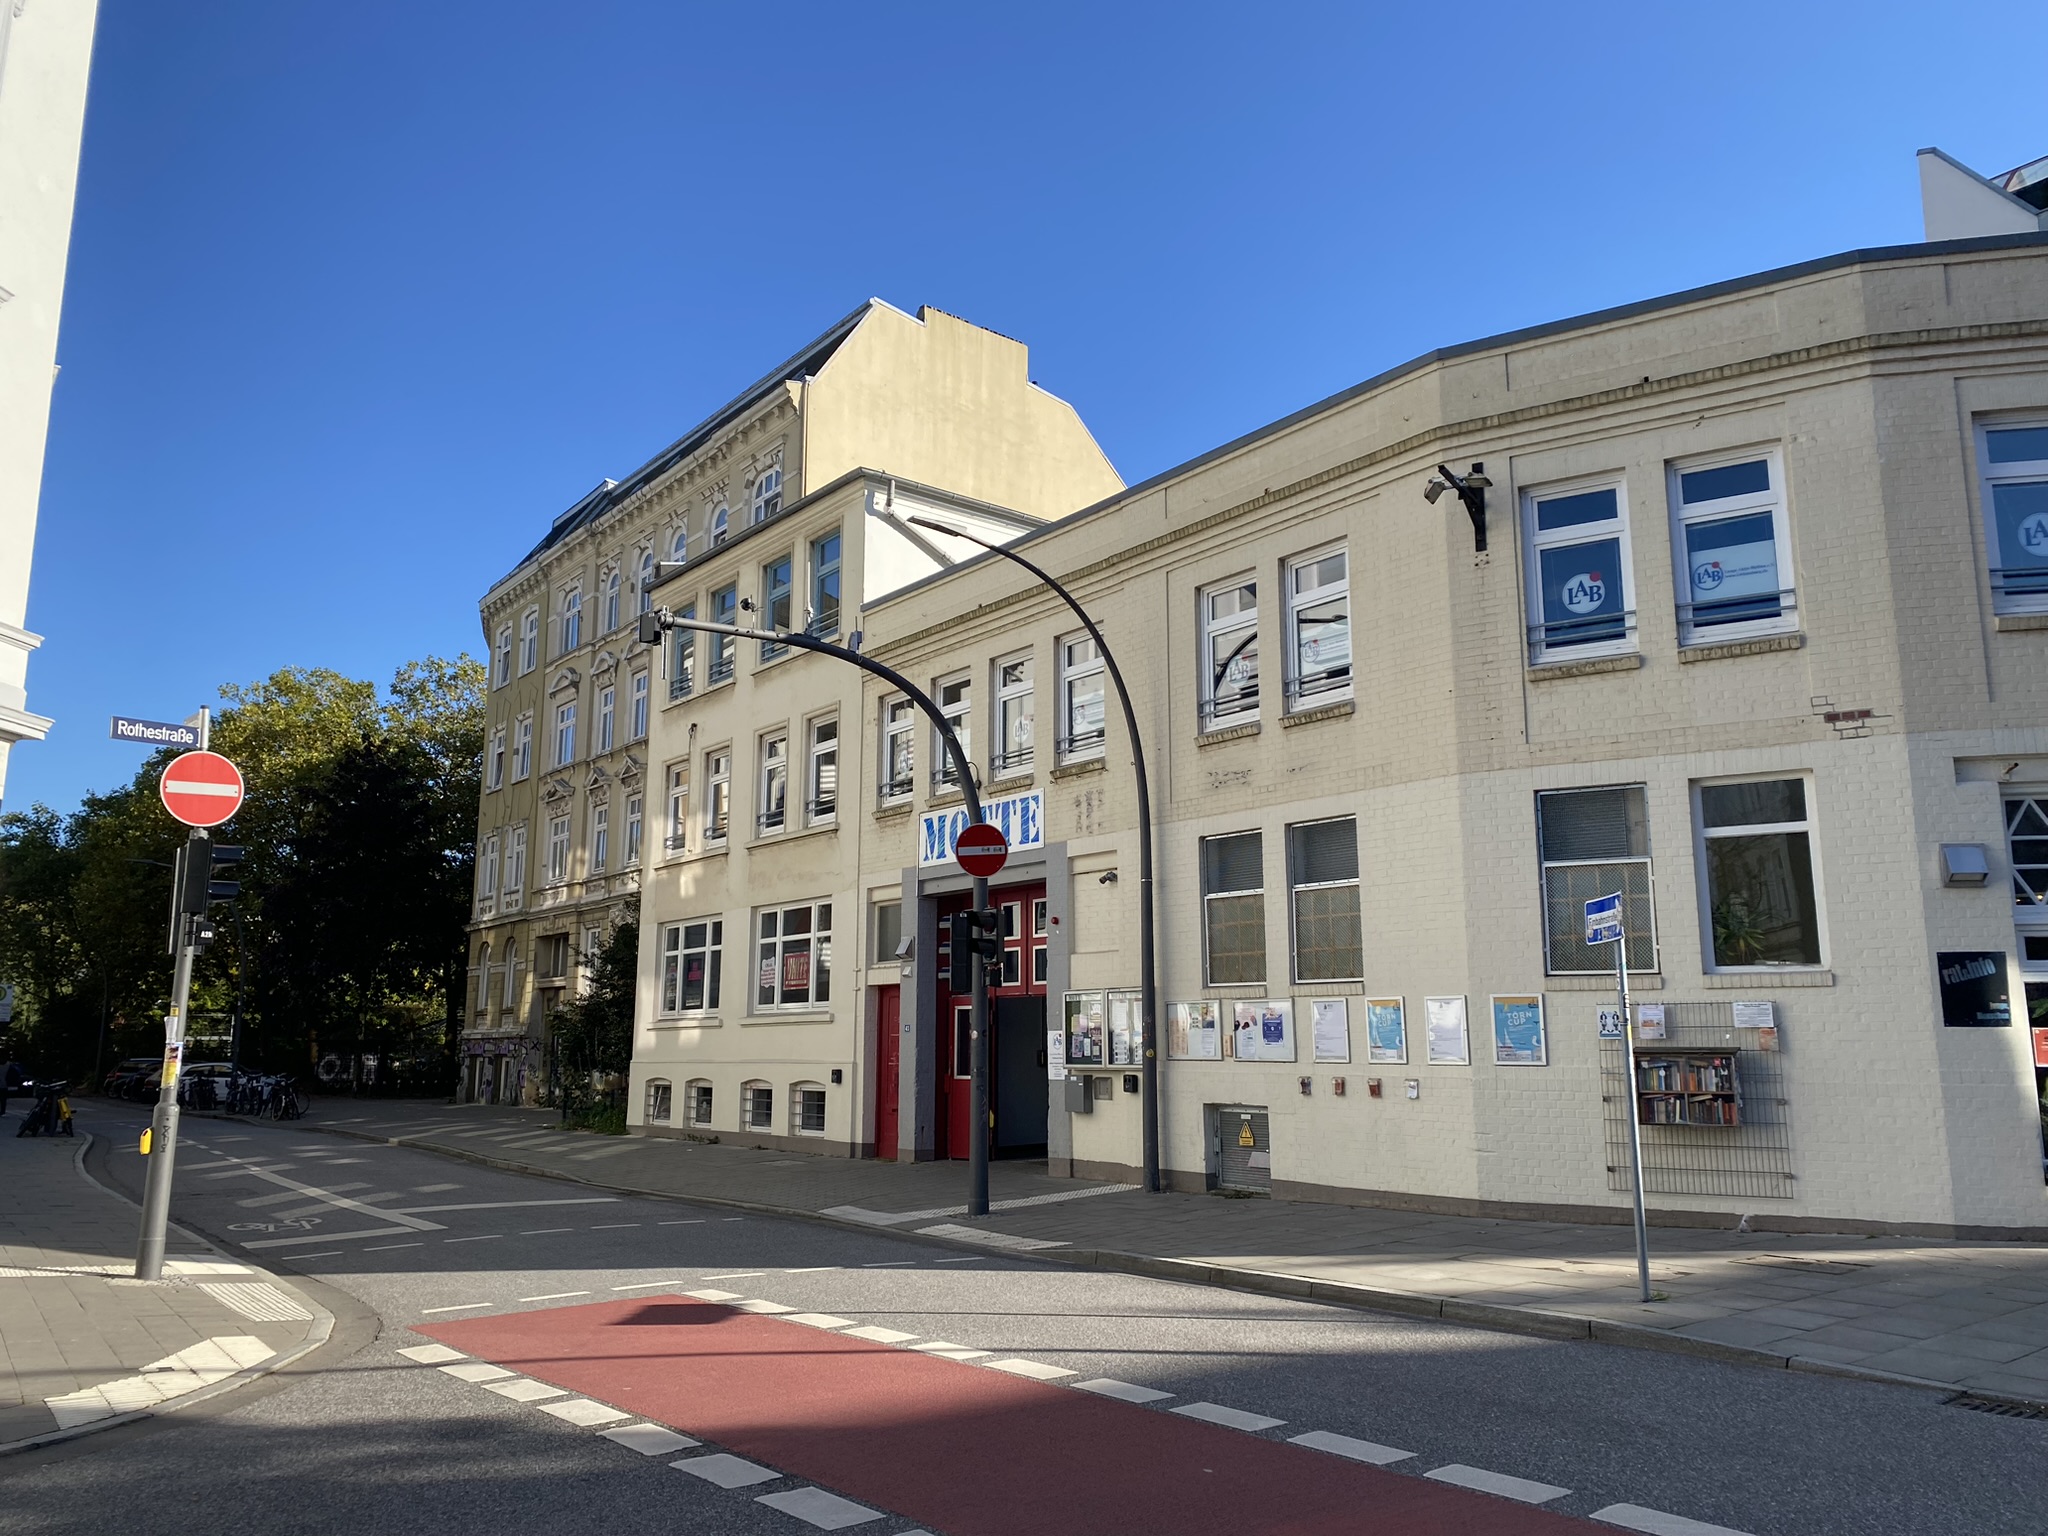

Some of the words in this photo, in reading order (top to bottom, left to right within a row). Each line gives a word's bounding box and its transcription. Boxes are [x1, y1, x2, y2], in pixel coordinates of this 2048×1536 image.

[2023, 518, 2048, 547] LA
[1696, 567, 1721, 585] LAB
[1567, 579, 1603, 606] LAB
[1229, 658, 1249, 683] LAB
[117, 719, 195, 744] Rothestraße
[1014, 718, 1029, 738] LAB
[1507, 1018, 1527, 1026] CUP
